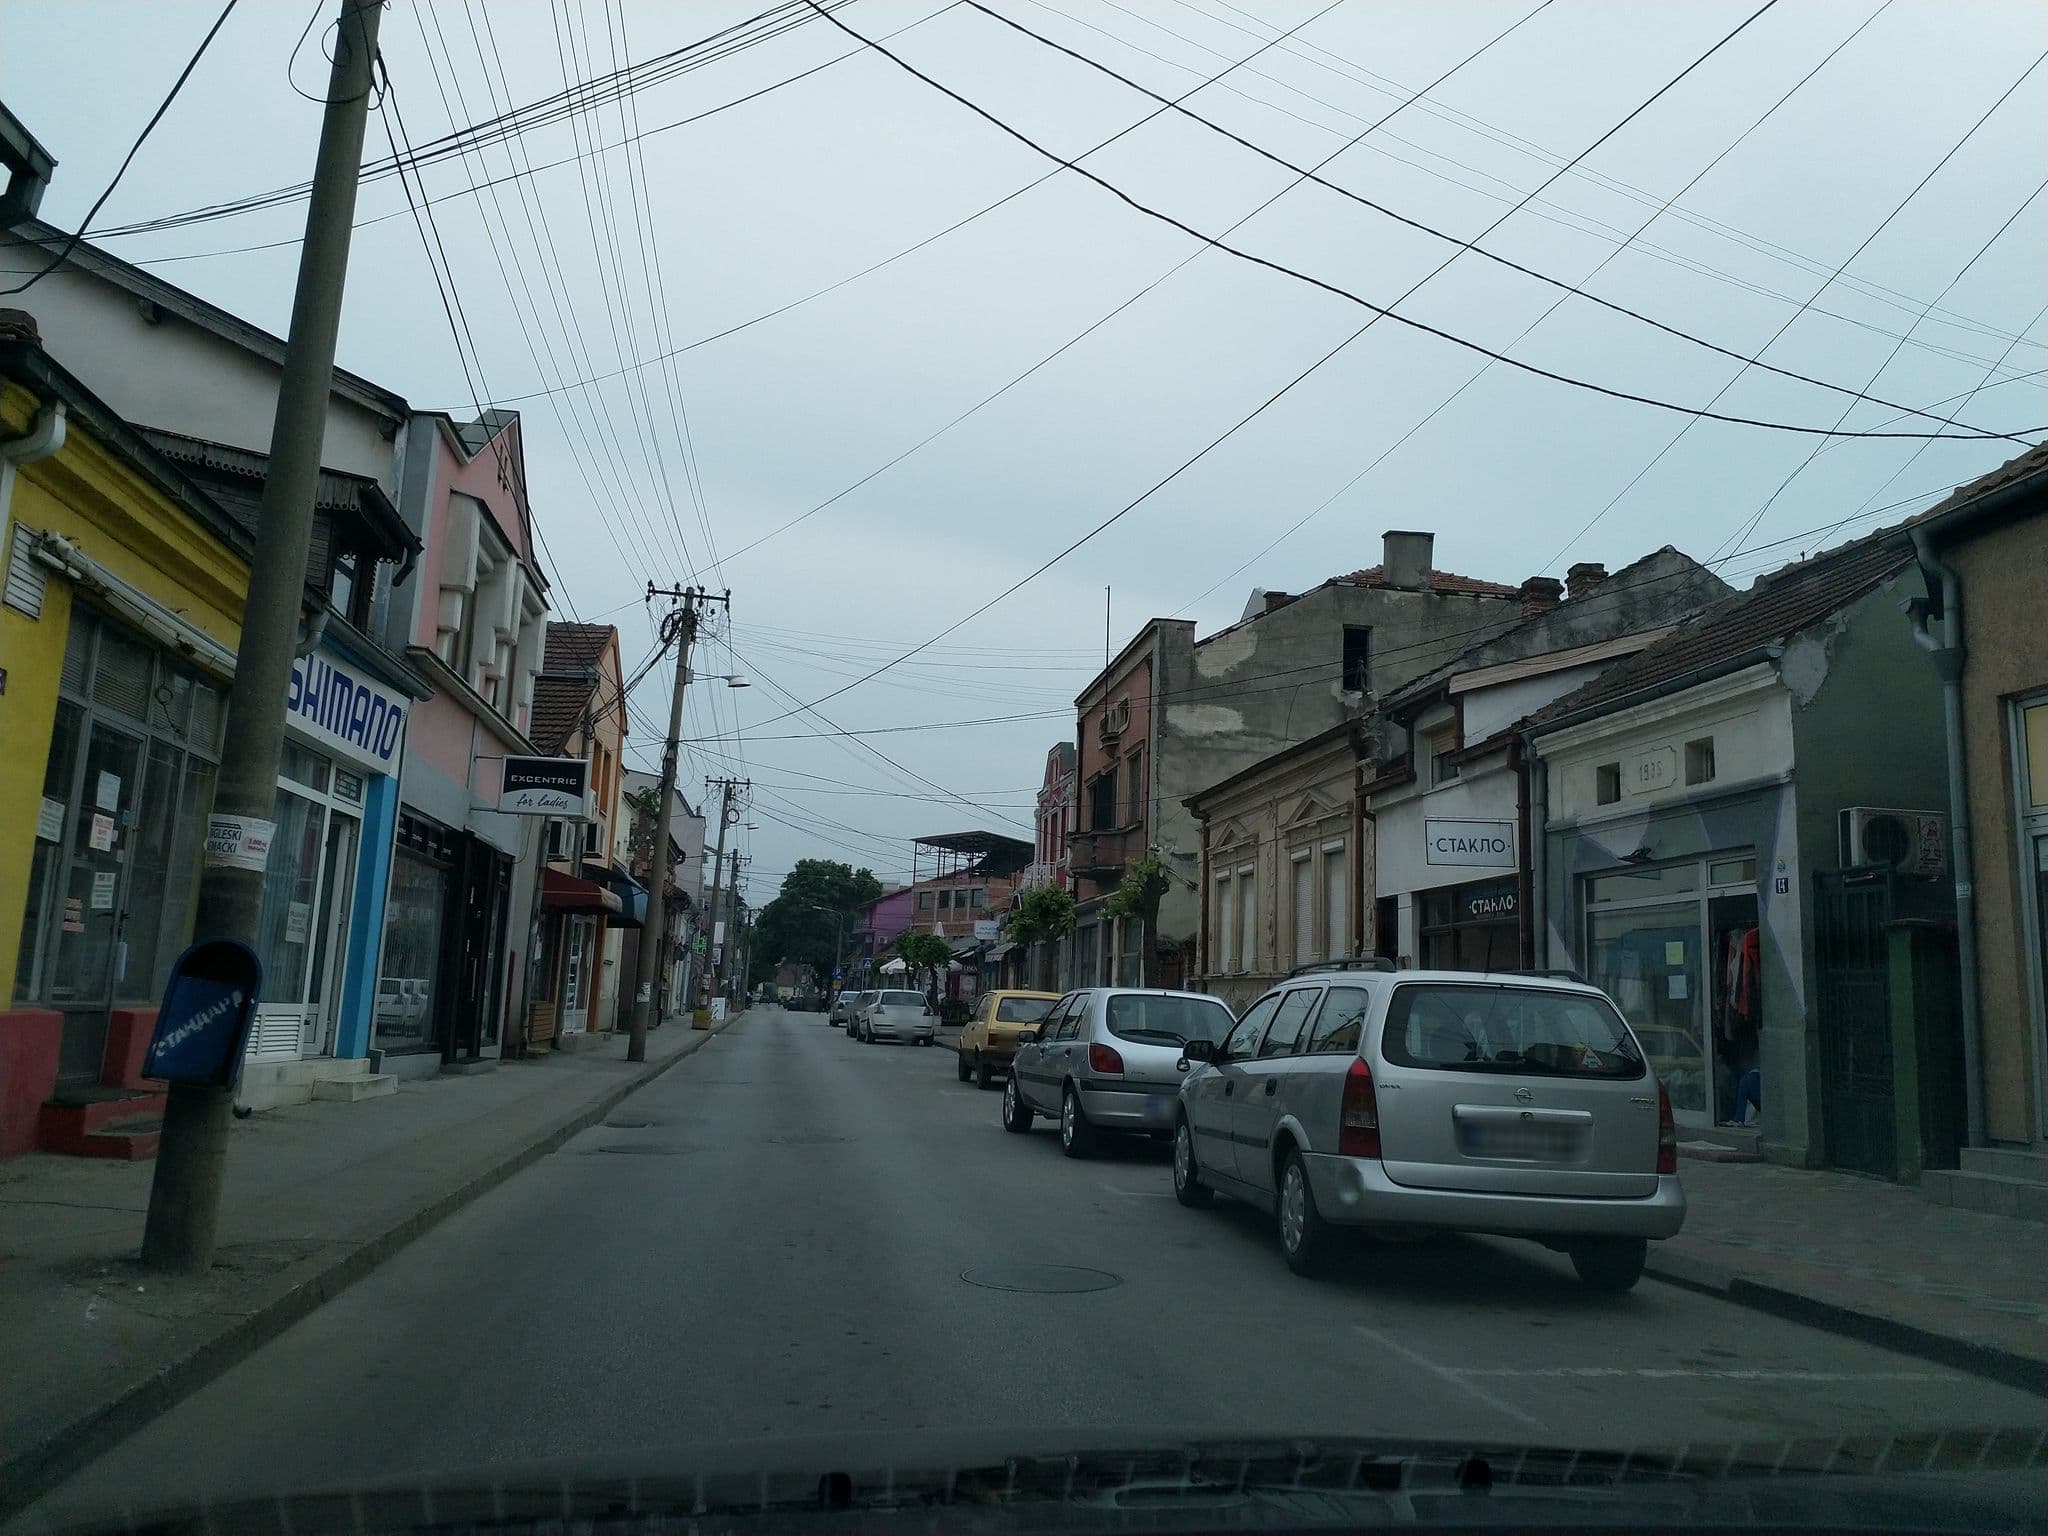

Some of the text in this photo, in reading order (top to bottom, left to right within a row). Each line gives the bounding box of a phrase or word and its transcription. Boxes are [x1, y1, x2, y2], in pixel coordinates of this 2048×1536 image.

[511, 774, 577, 785] EXCENTRIC
[515, 793, 569, 809] for ladies
[1436, 838, 1506, 853] СТАКЛО
[1777, 879, 1786, 893] 14
